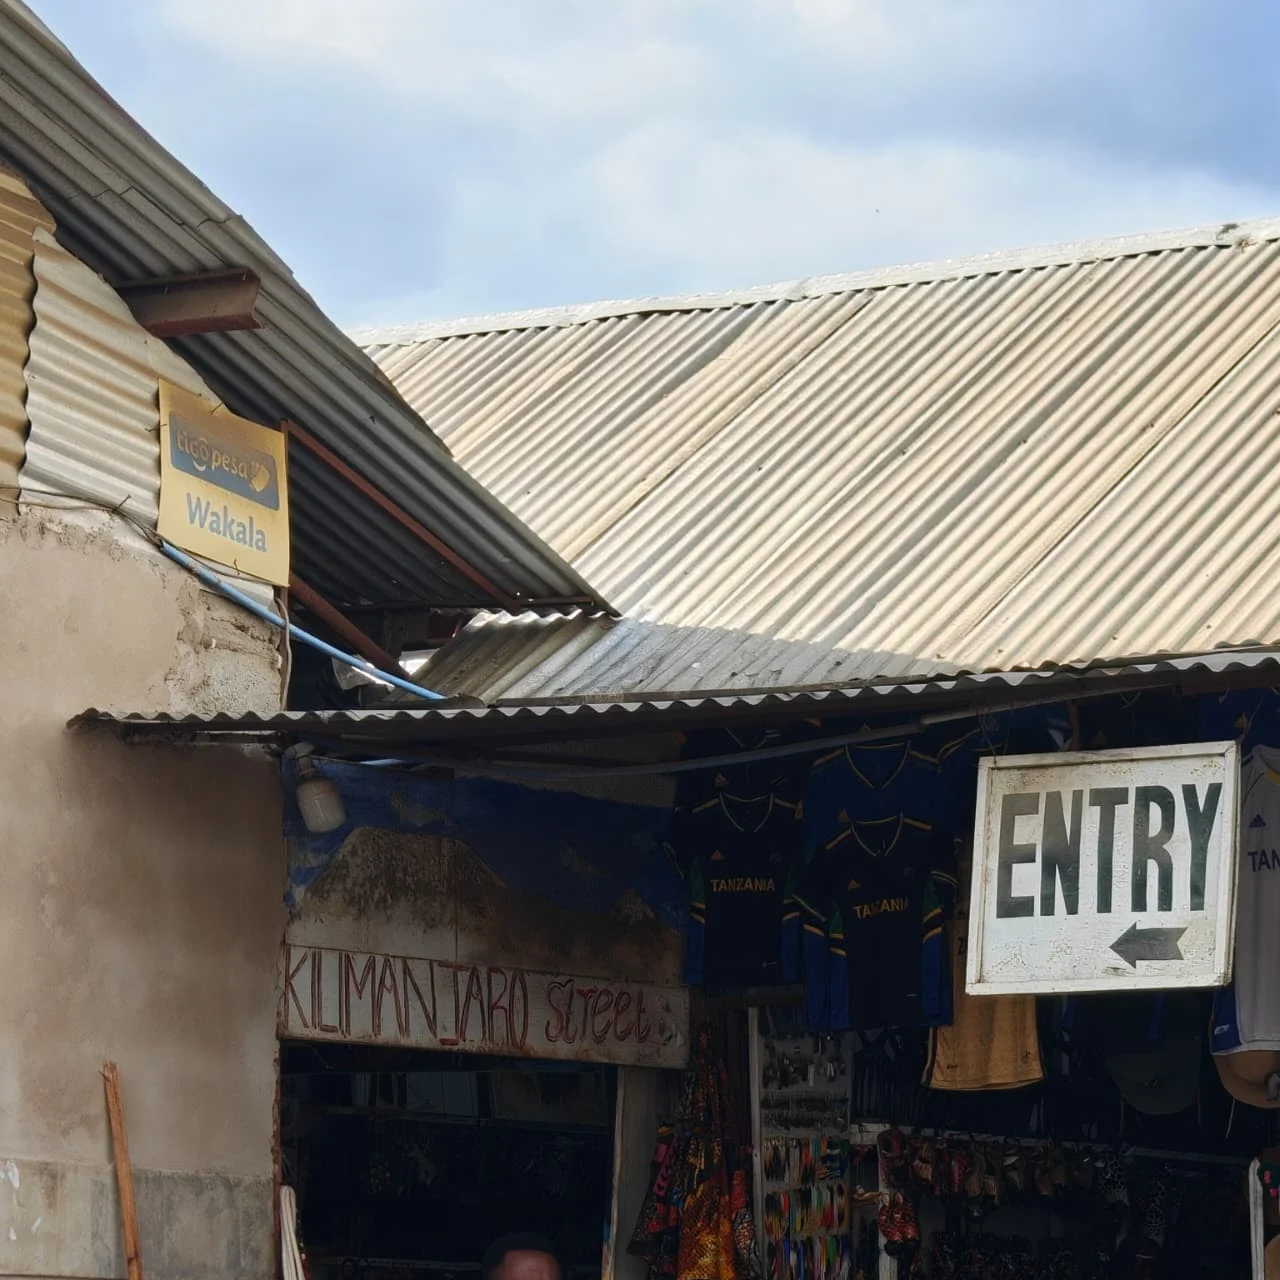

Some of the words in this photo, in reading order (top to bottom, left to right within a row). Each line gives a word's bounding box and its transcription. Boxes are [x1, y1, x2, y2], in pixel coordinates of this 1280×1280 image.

[211, 448, 248, 480] pesa
[186, 492, 268, 552] Wakala
[996, 782, 1222, 919] ENTRY
[709, 877, 775, 893] TANZANIA
